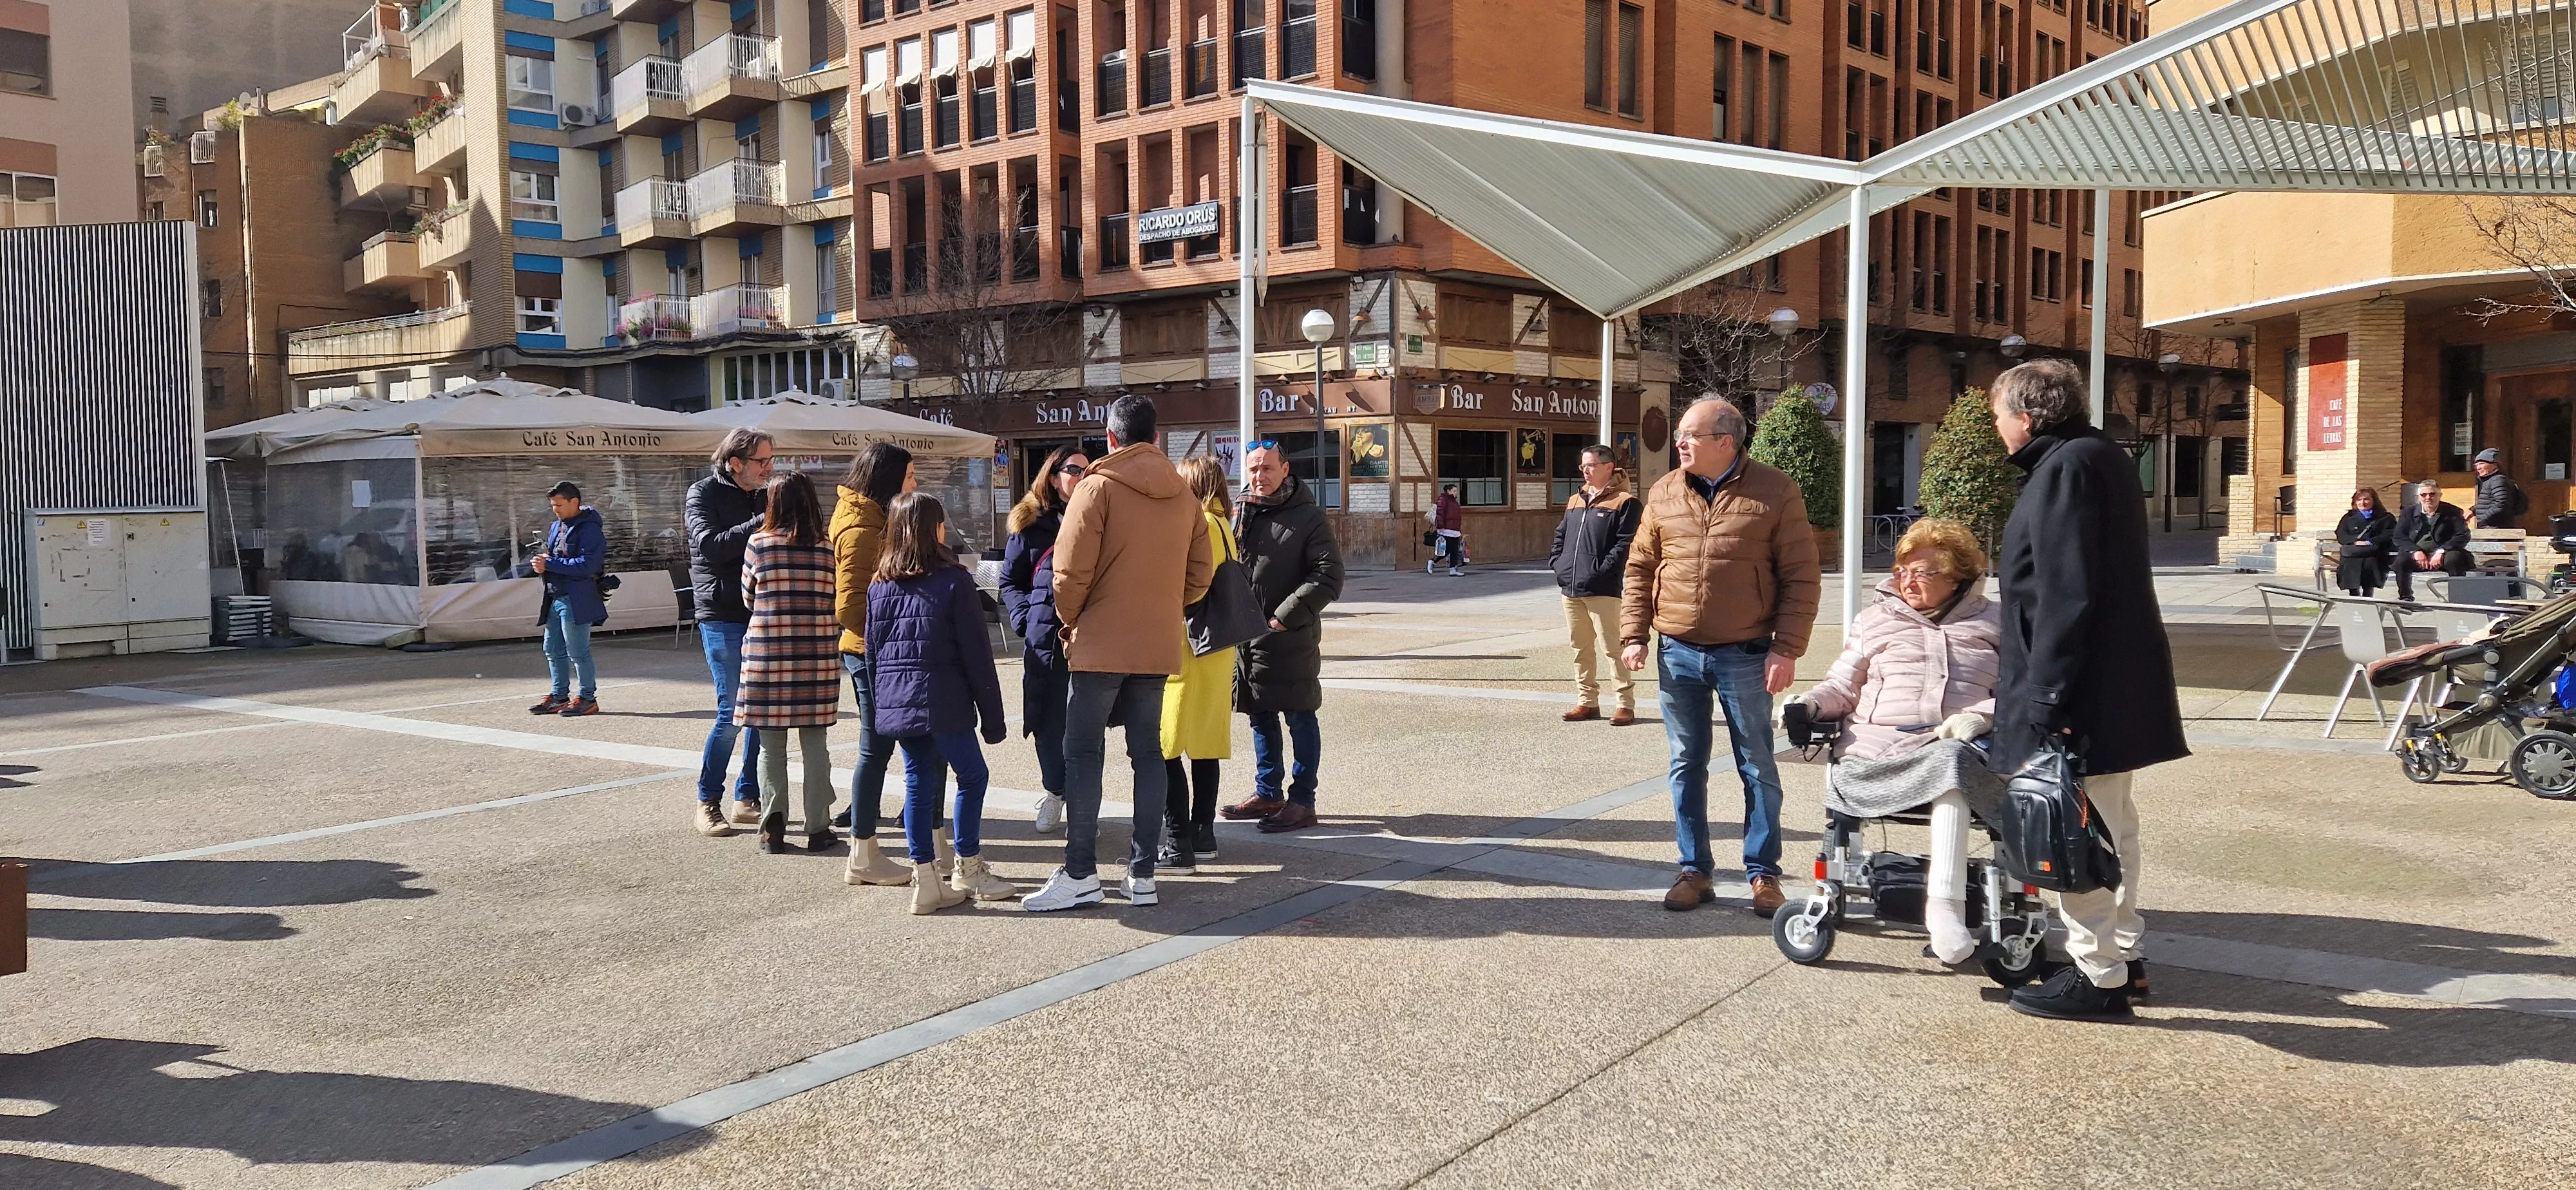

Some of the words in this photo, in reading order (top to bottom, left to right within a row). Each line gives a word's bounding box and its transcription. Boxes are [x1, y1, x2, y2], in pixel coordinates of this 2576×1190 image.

[1139, 212, 1184, 232] RICARDO
[1186, 205, 1216, 225] ORÚS
[1139, 231, 1171, 241] DESPACHO
[1181, 223, 1216, 236] ABOGADOS
[1259, 388, 1299, 413] Bar
[1450, 384, 1484, 410] Bar
[1511, 388, 1544, 417] San
[1548, 390, 1602, 419] Antoni
[920, 407, 954, 426] Café
[1036, 402, 1071, 426] San
[2333, 415, 2342, 427] LAS
[522, 431, 557, 447] Café
[565, 430, 595, 449] San
[600, 430, 661, 449] Antonio
[832, 432, 858, 446] Café
[891, 435, 934, 451] Antonio
[2323, 432, 2342, 444] LETRAS
